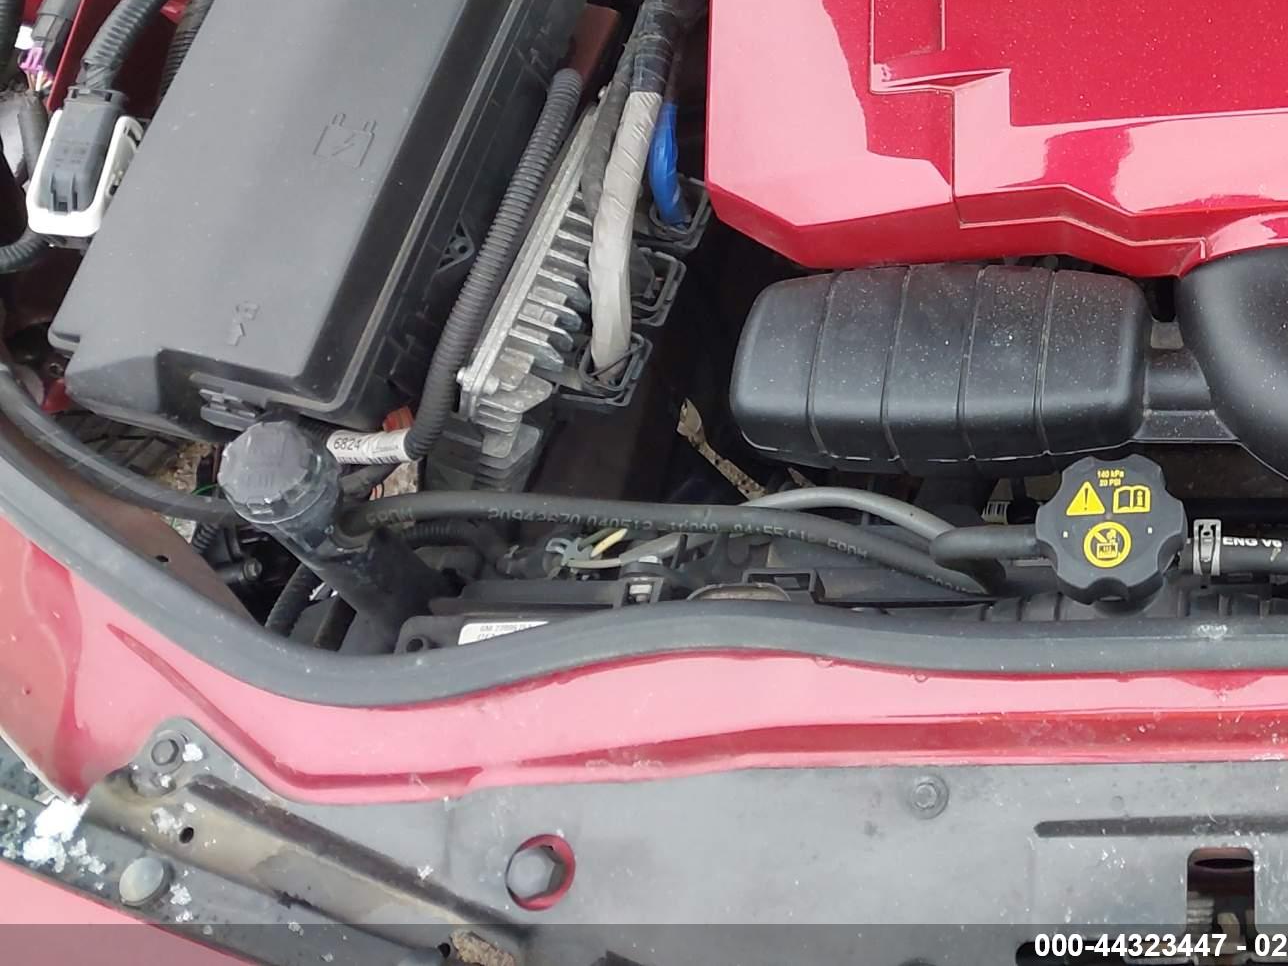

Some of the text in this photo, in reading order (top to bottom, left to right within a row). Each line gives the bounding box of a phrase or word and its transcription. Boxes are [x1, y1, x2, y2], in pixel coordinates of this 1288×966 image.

[334, 436, 362, 451] 6824
[1097, 469, 1125, 478] 140 kPa
[1109, 478, 1121, 487] PSI
[1223, 536, 1282, 548] ENG V6
